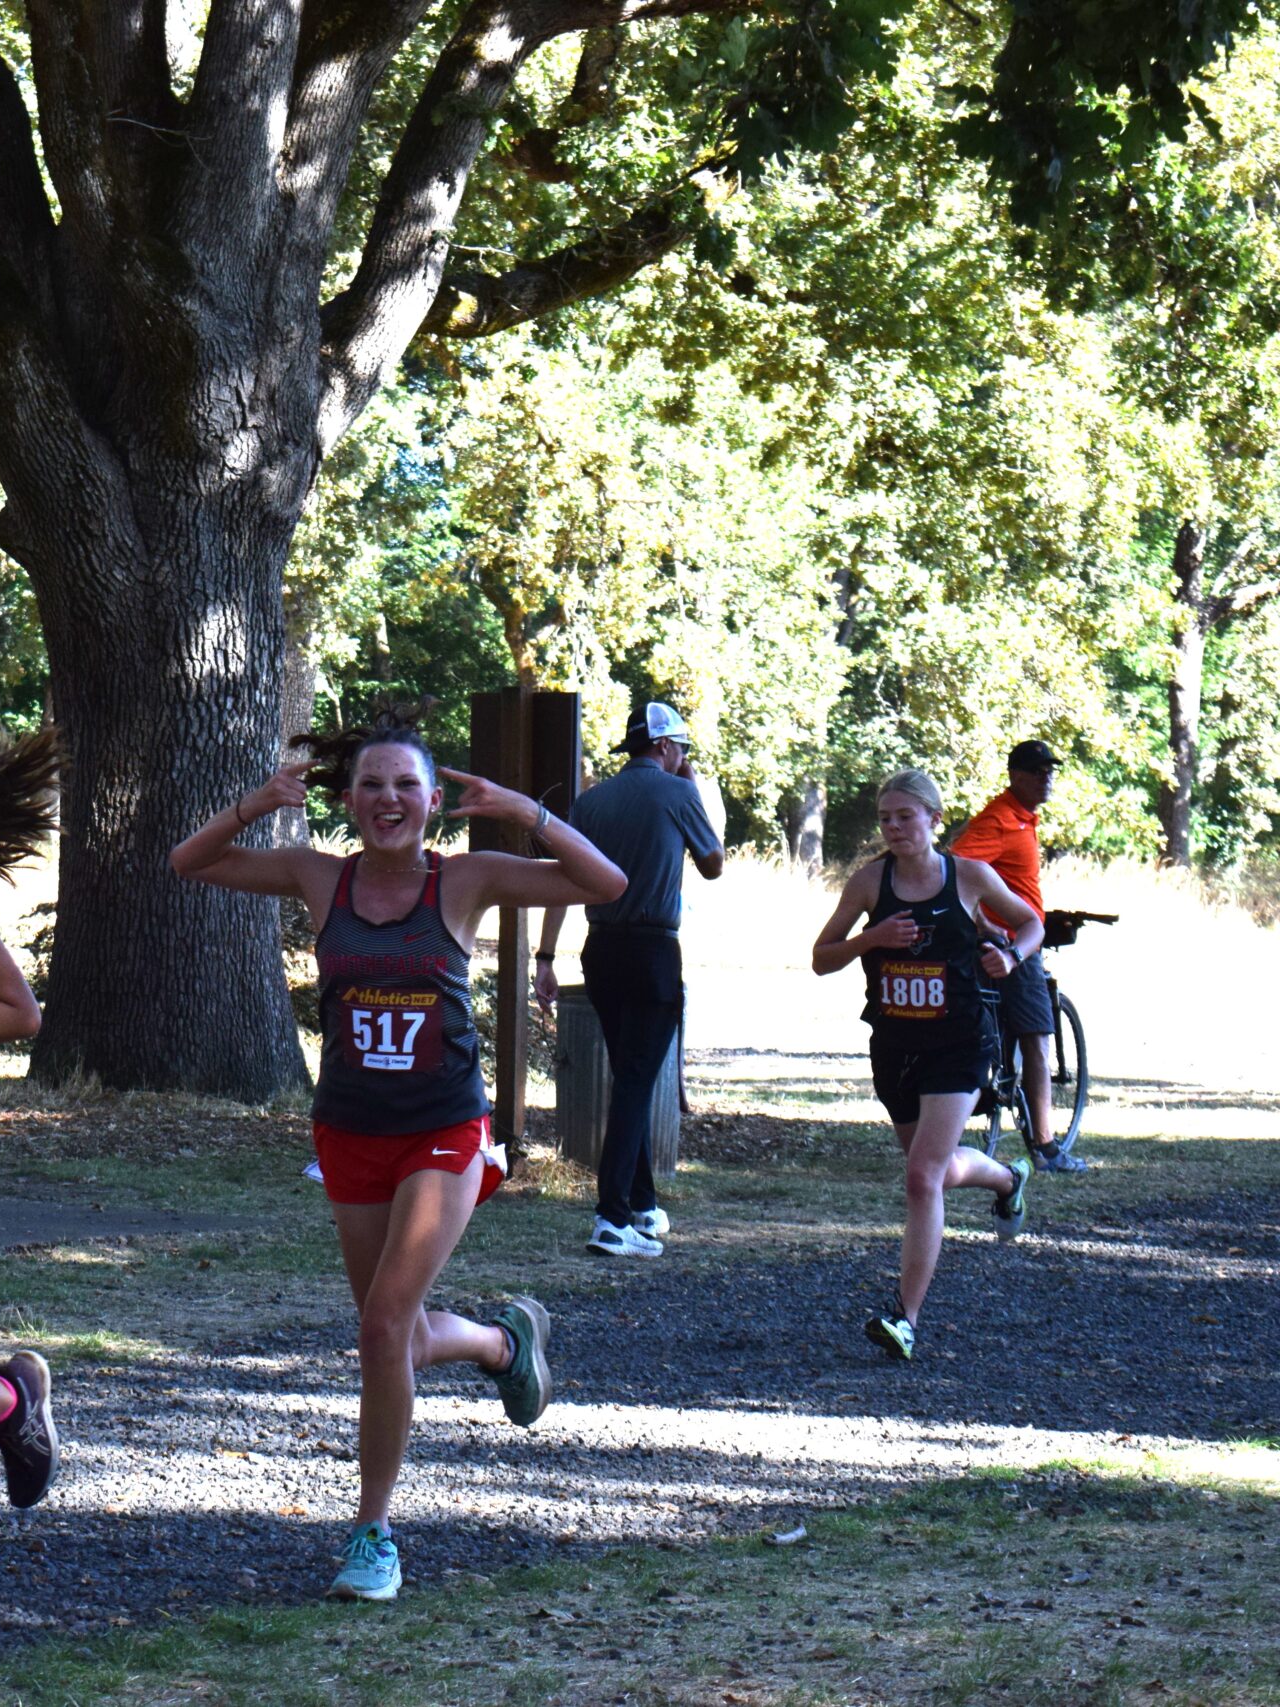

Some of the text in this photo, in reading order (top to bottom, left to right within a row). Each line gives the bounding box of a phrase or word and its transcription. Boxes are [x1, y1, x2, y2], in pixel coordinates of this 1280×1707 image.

[882, 962, 924, 975] Athletic
[342, 986, 411, 1005] Athletic
[880, 975, 944, 1007] 1808
[352, 1009, 426, 1053] 517
